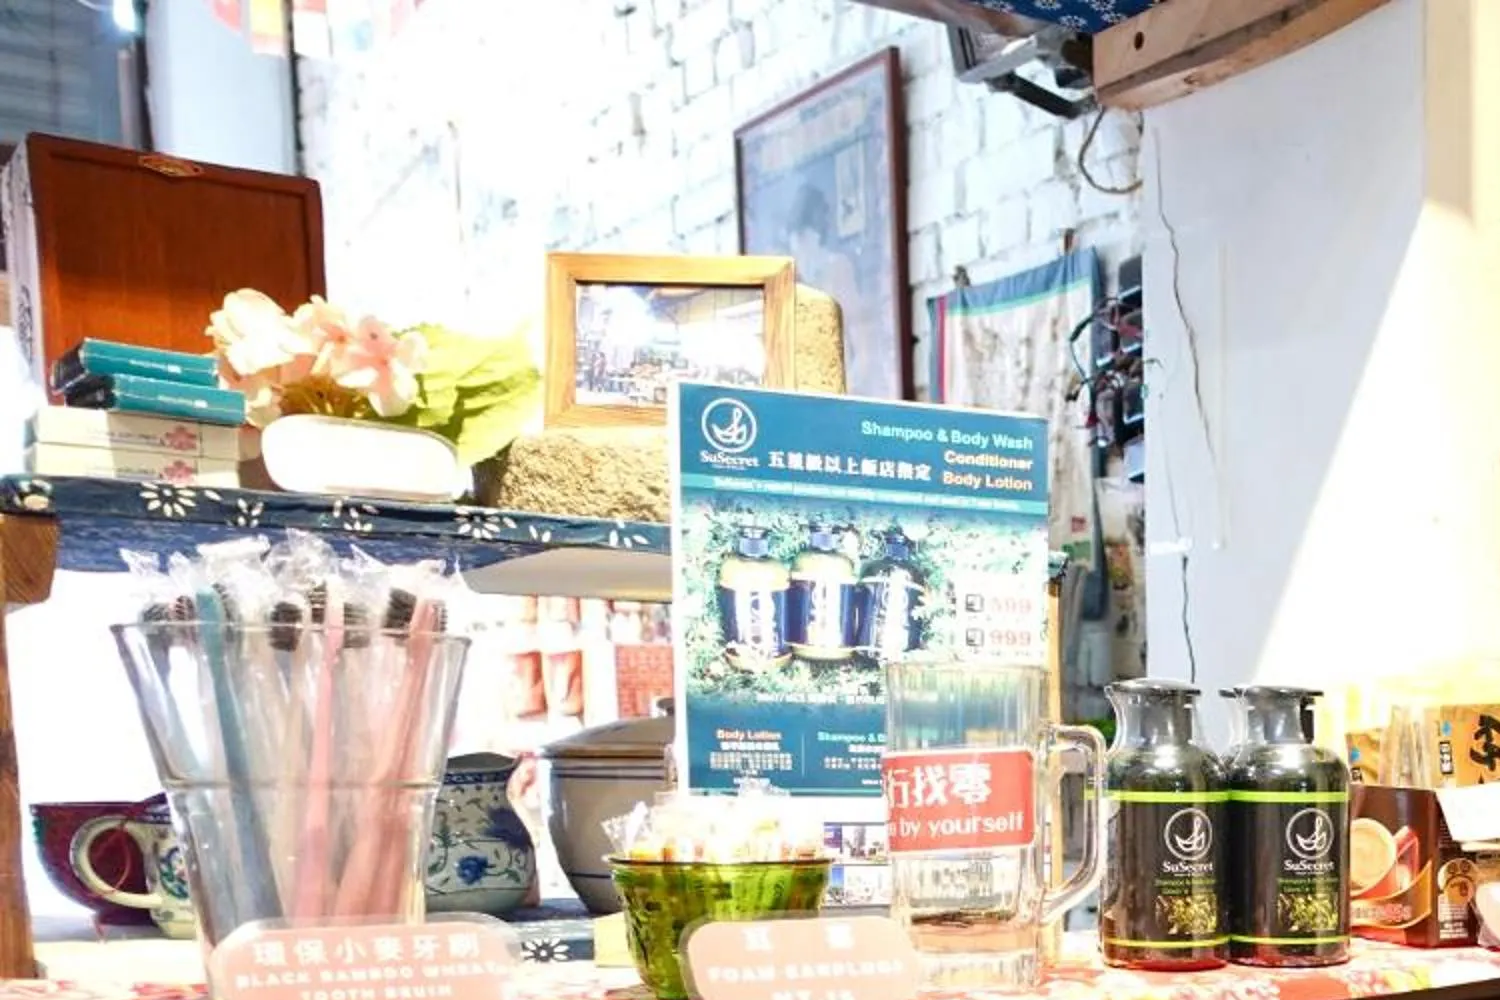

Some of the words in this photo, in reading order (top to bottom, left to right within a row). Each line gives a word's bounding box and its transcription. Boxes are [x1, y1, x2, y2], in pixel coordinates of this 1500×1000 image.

[861, 420, 932, 443] Shampoo
[937, 428, 948, 442] &
[951, 429, 988, 449] Body
[992, 434, 1033, 450] Wash
[700, 450, 759, 467] SuSecret
[943, 449, 1034, 470] Conditioner
[943, 471, 982, 490] Body
[985, 473, 1033, 491] Lotion
[900, 817, 920, 838] by
[928, 811, 1024, 839] yourself
[1162, 860, 1214, 873] SuSecret
[1283, 859, 1334, 872] SuSecret
[235, 972, 310, 989] BLACK
[320, 966, 414, 983] BAMBOO
[707, 965, 776, 983] FOAM
[785, 959, 904, 980] EARPLUGS
[384, 985, 453, 999] BRUSH
